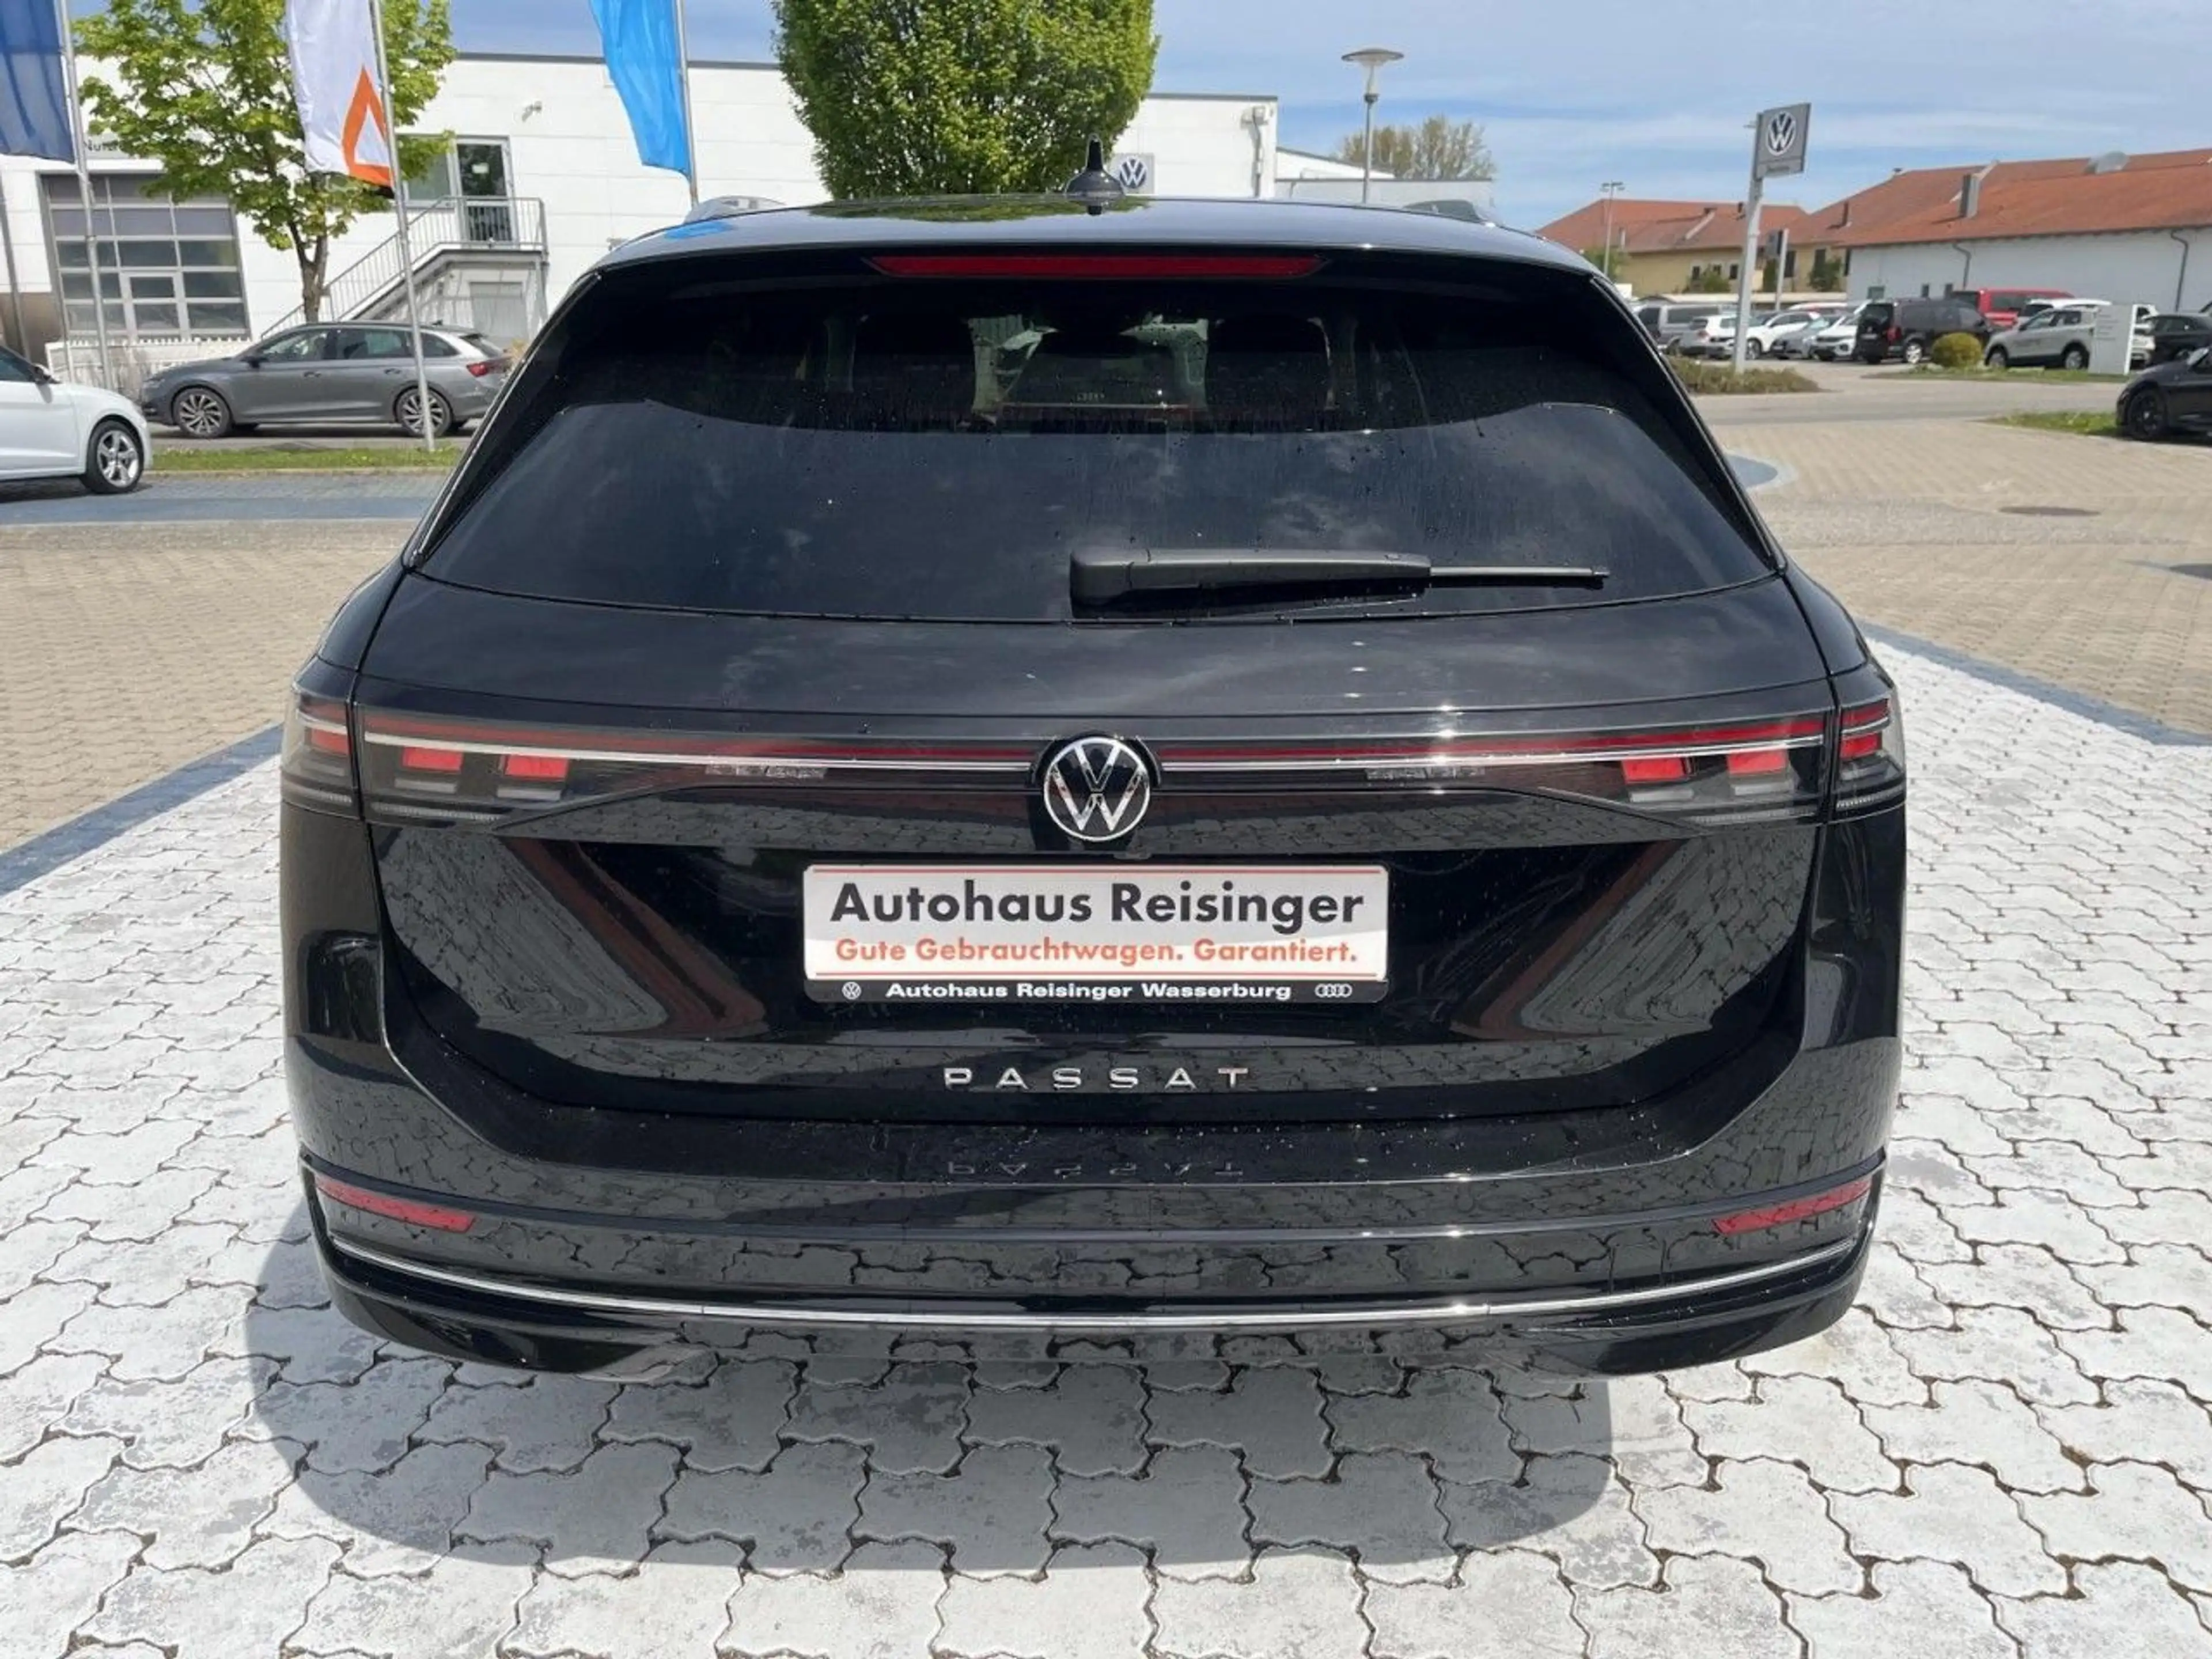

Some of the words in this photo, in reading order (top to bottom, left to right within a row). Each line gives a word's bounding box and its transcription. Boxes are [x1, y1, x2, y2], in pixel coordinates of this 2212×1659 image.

[830, 879, 1092, 922] Autohaus
[1111, 881, 1363, 934] Reisinger
[836, 938, 906, 961] Gute
[915, 937, 1183, 967] Gebrauchtwagen.
[1194, 939, 1357, 962] Garantiert.
[885, 983, 1008, 998] Autohaus
[1016, 982, 1132, 1001] Reisinger
[1141, 983, 1291, 1001] Wasserburg
[944, 1067, 1249, 1090] PASSAT
